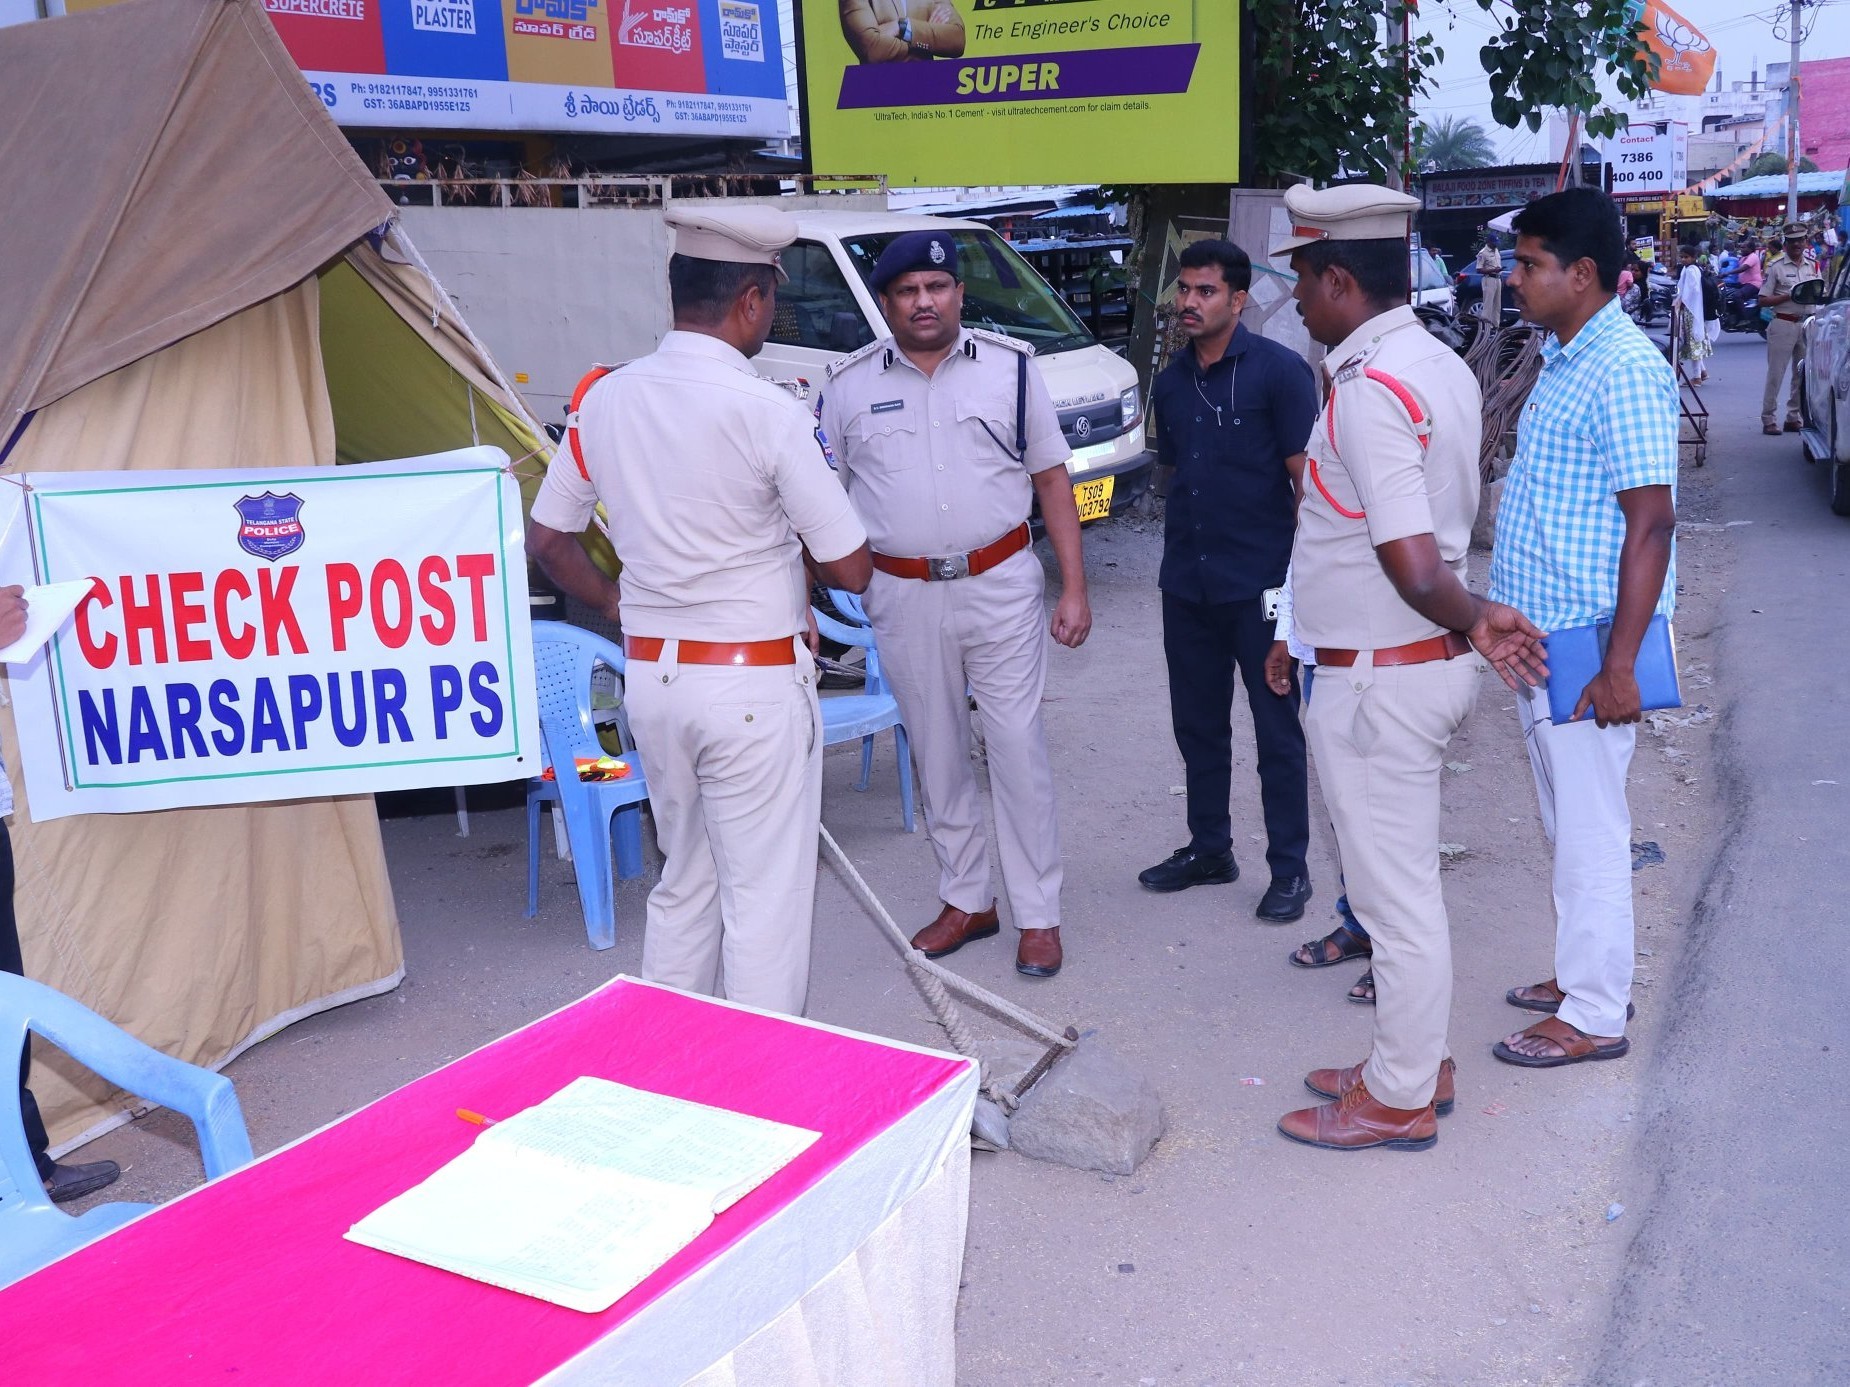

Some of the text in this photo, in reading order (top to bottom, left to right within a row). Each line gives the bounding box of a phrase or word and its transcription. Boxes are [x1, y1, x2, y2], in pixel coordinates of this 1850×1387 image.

[269, 0, 364, 17] SUPERCRETE
[416, 5, 472, 29] PLASTER
[723, 21, 759, 40] సూపర్
[975, 12, 1170, 40] The Engineer's Choice
[955, 62, 1060, 95] SUPER
[351, 83, 478, 98] Ph: 9182117847, 9951331761
[363, 98, 471, 112] GST: 36ABAPD1955E1Z5
[564, 91, 578, 118] శ్రీ
[581, 94, 620, 115] సాయి
[666, 99, 677, 108] Ph:
[911, 110, 934, 120] India's
[935, 110, 948, 119] No.
[991, 107, 1006, 116] visit
[1007, 104, 1086, 116] ultratechcement.com
[1087, 102, 1098, 112] for
[1100, 102, 1121, 111] claim
[1122, 100, 1152, 110] details.
[674, 111, 690, 120] GST:
[1620, 135, 1654, 144] Contact
[1621, 152, 1653, 163] 7386
[1612, 172, 1634, 182] 400
[1638, 170, 1663, 181] 400
[1432, 183, 1456, 193] BALAJI
[1457, 180, 1476, 191] FOOD
[1477, 180, 1496, 190] ZONE
[1532, 177, 1546, 187] TEA
[1083, 483, 1104, 502] TS09
[278, 517, 295, 525] STATE
[244, 523, 299, 536] POLICE
[75, 553, 495, 669] CHECK POST
[78, 660, 503, 766] NARSAPUR PS
